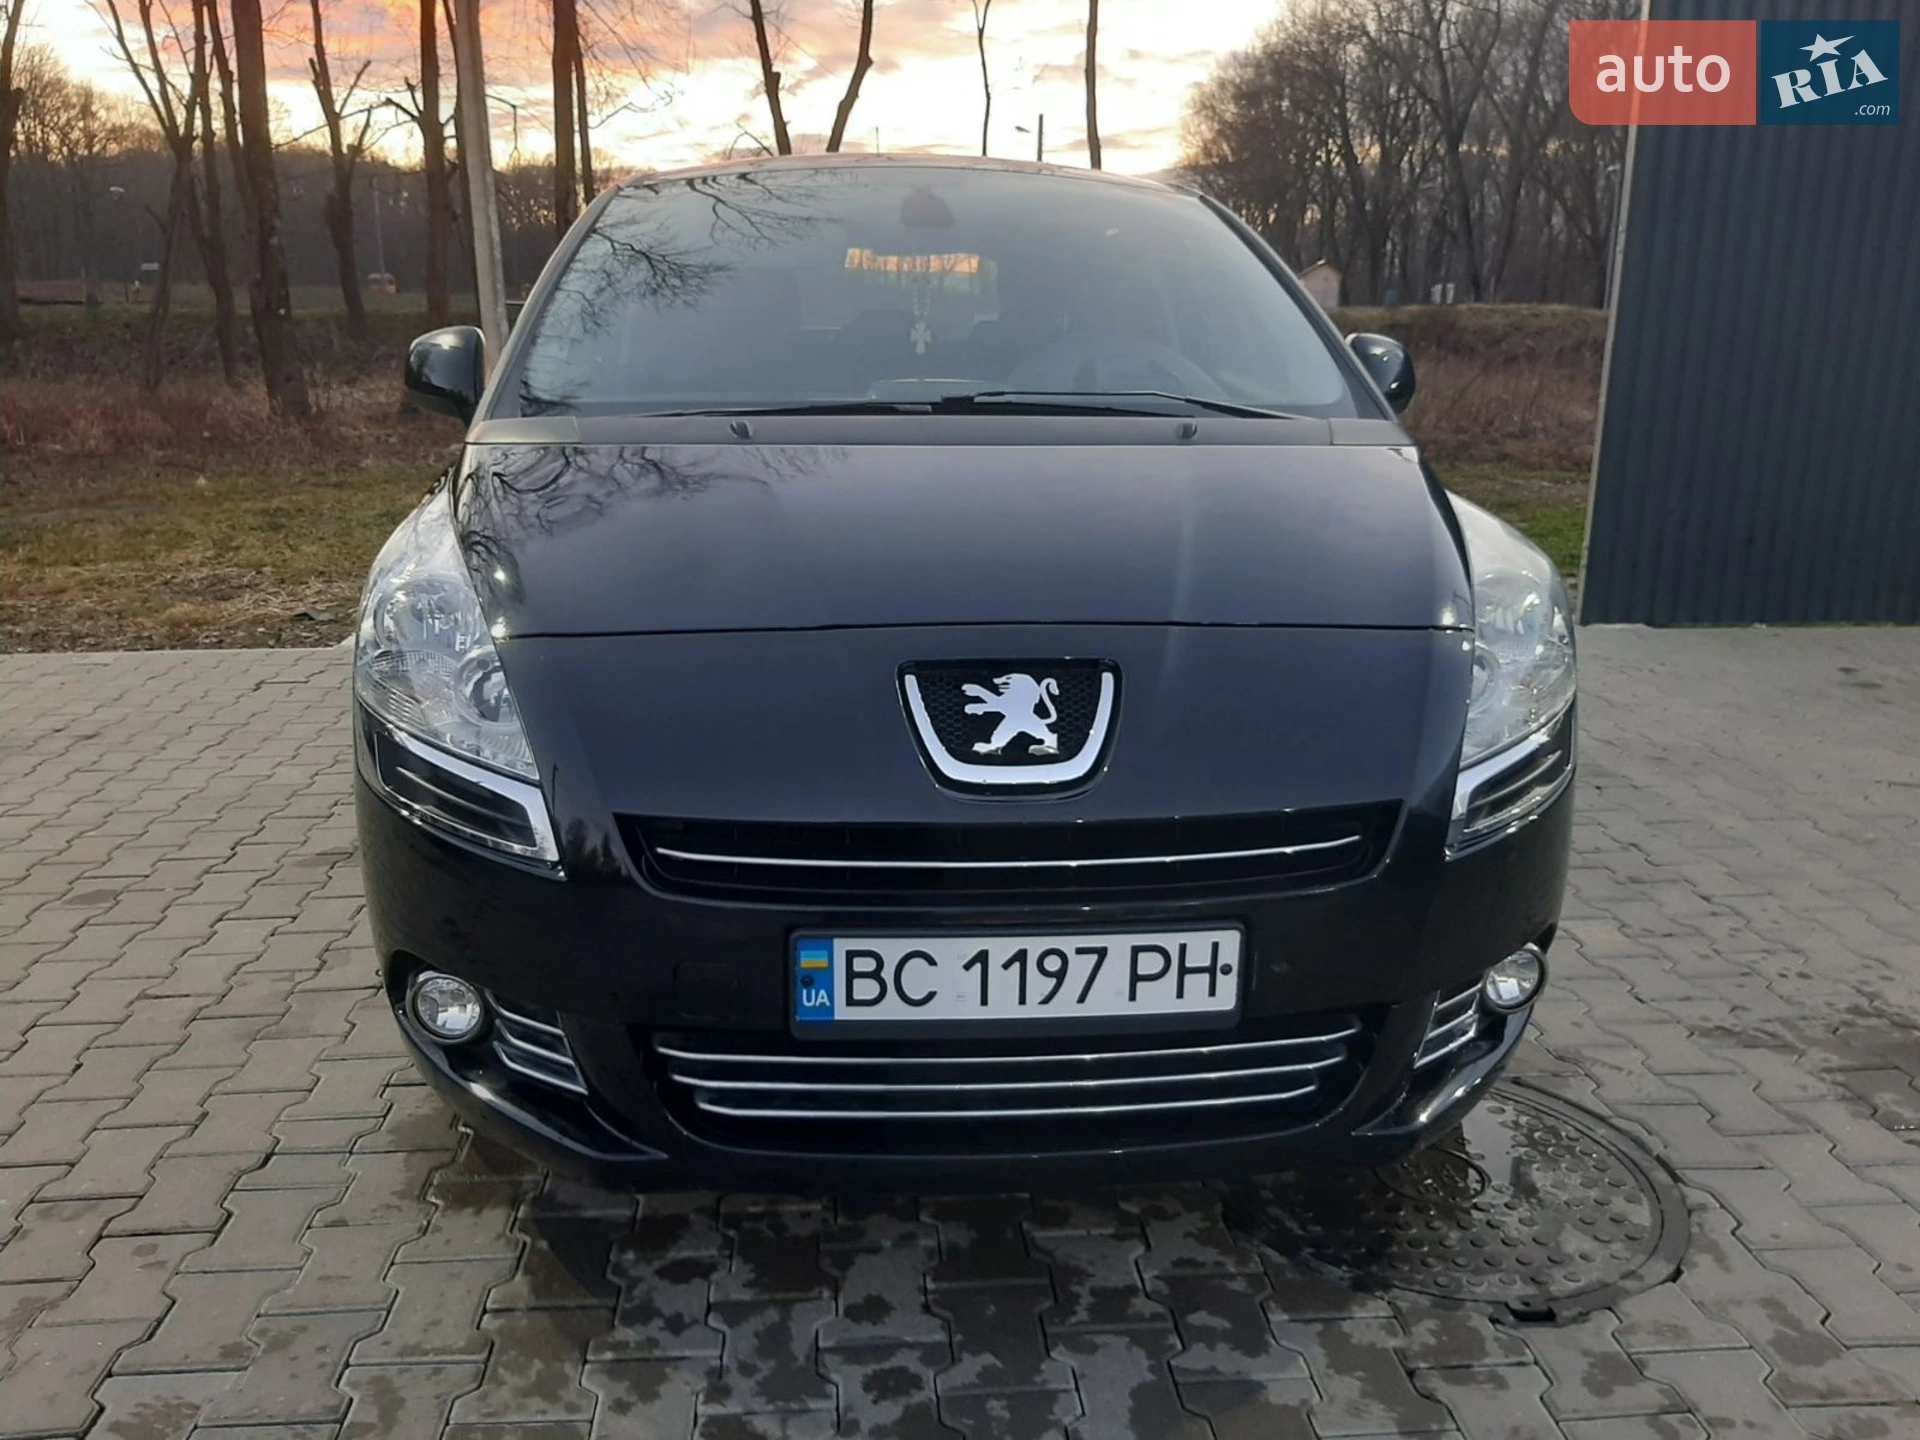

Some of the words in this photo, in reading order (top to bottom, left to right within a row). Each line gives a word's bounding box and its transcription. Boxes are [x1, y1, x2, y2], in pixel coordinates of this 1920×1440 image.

[845, 948, 938, 1007] BC
[962, 946, 1108, 1006] 1197
[1128, 941, 1219, 1002] PH
[802, 988, 831, 1007] UA
